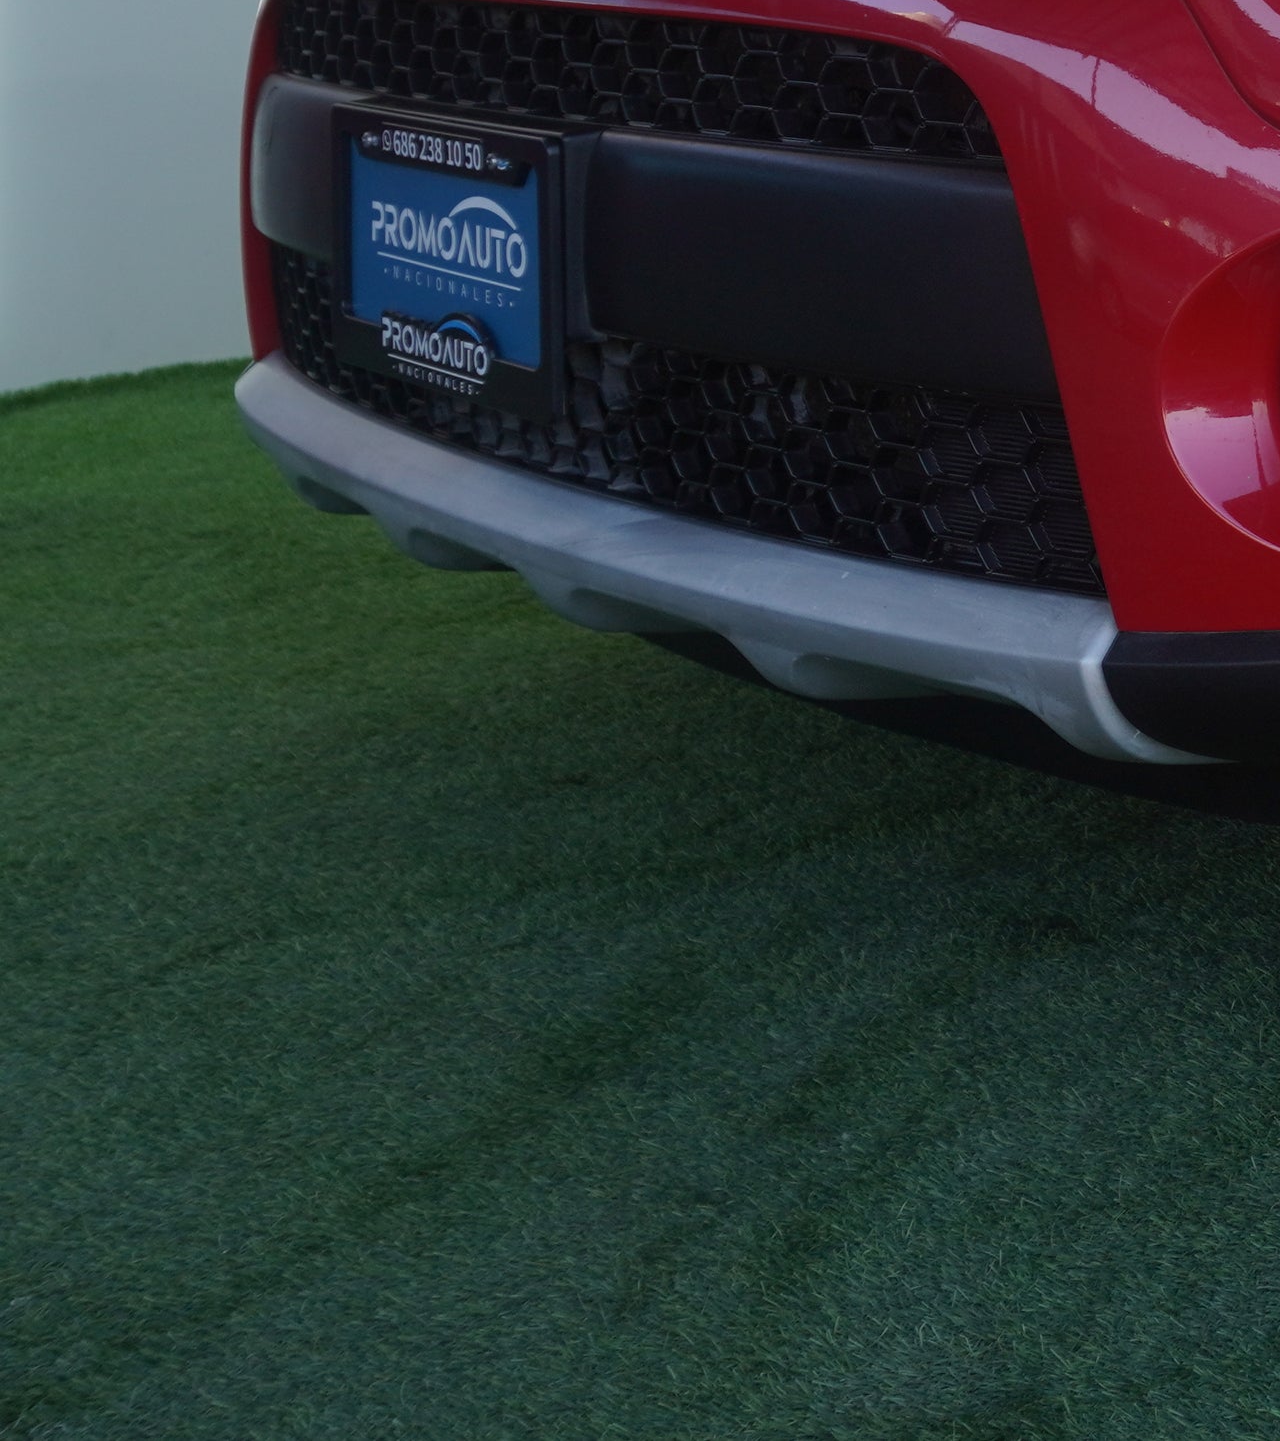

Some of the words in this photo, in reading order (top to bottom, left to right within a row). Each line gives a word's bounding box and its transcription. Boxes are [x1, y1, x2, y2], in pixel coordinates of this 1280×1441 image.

[393, 130, 417, 159] 686
[419, 134, 443, 164] 238
[446, 139, 461, 168] 10
[464, 142, 481, 171] 50
[370, 200, 528, 278] PROMOAUTO
[392, 265, 504, 308] NACIONALES
[381, 316, 488, 376] PROMOAUTO
